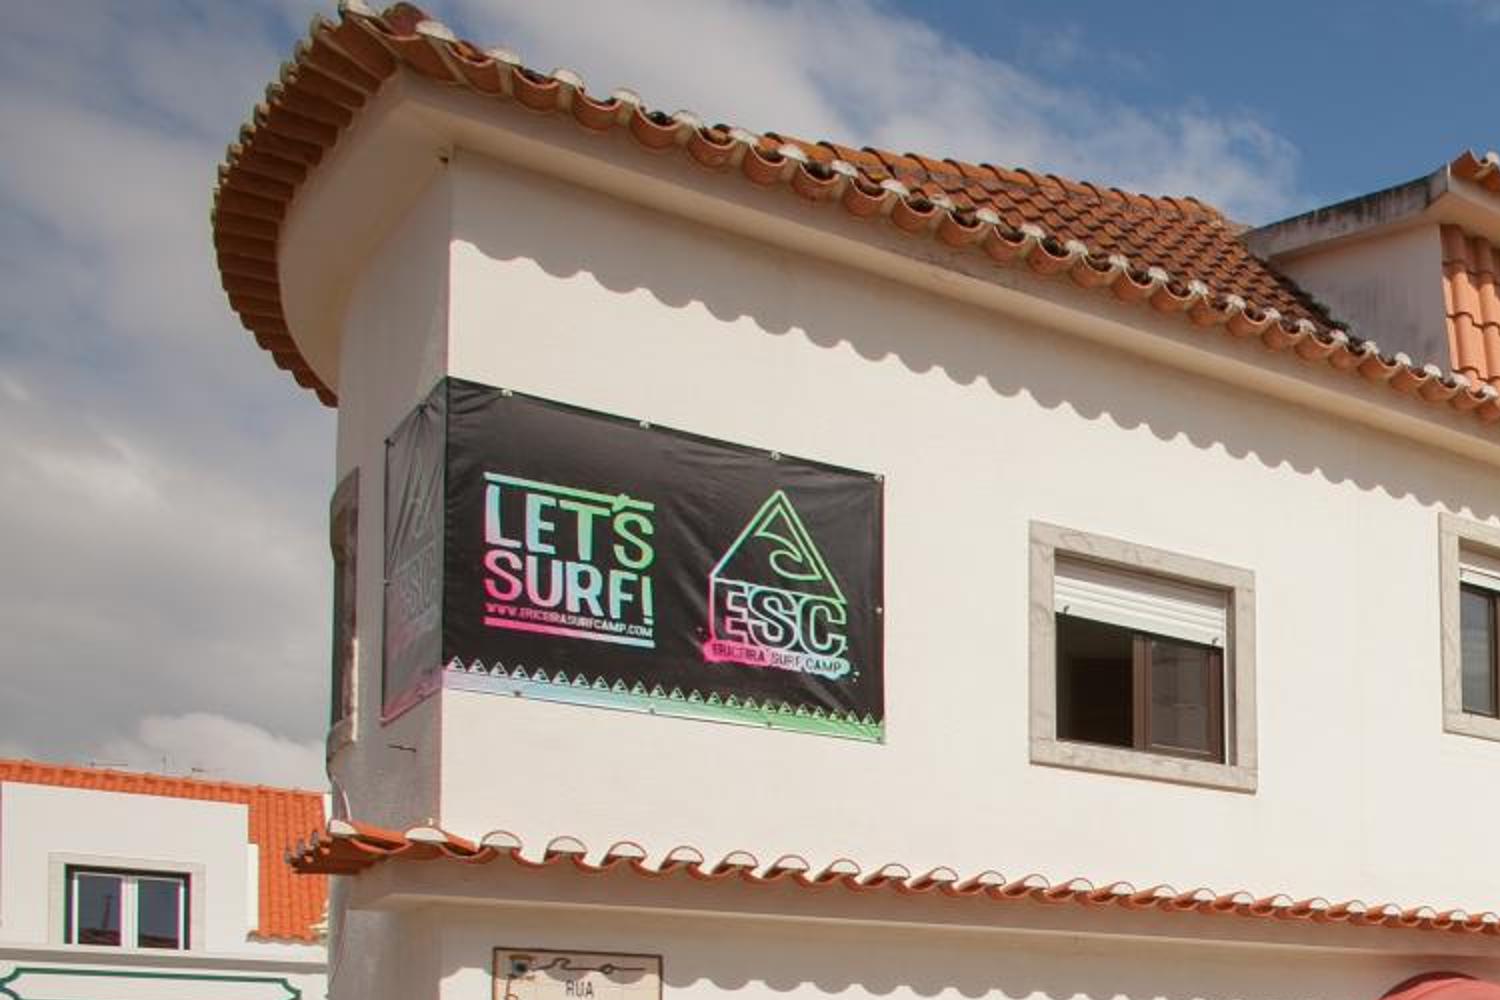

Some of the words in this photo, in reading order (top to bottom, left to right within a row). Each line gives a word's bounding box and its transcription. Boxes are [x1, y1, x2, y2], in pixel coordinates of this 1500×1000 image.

[484, 549, 654, 625] SURF!
[711, 578, 847, 658] ESC
[771, 651, 801, 668] SURF
[805, 658, 842, 673] CAMP
[565, 980, 594, 999] RUA
